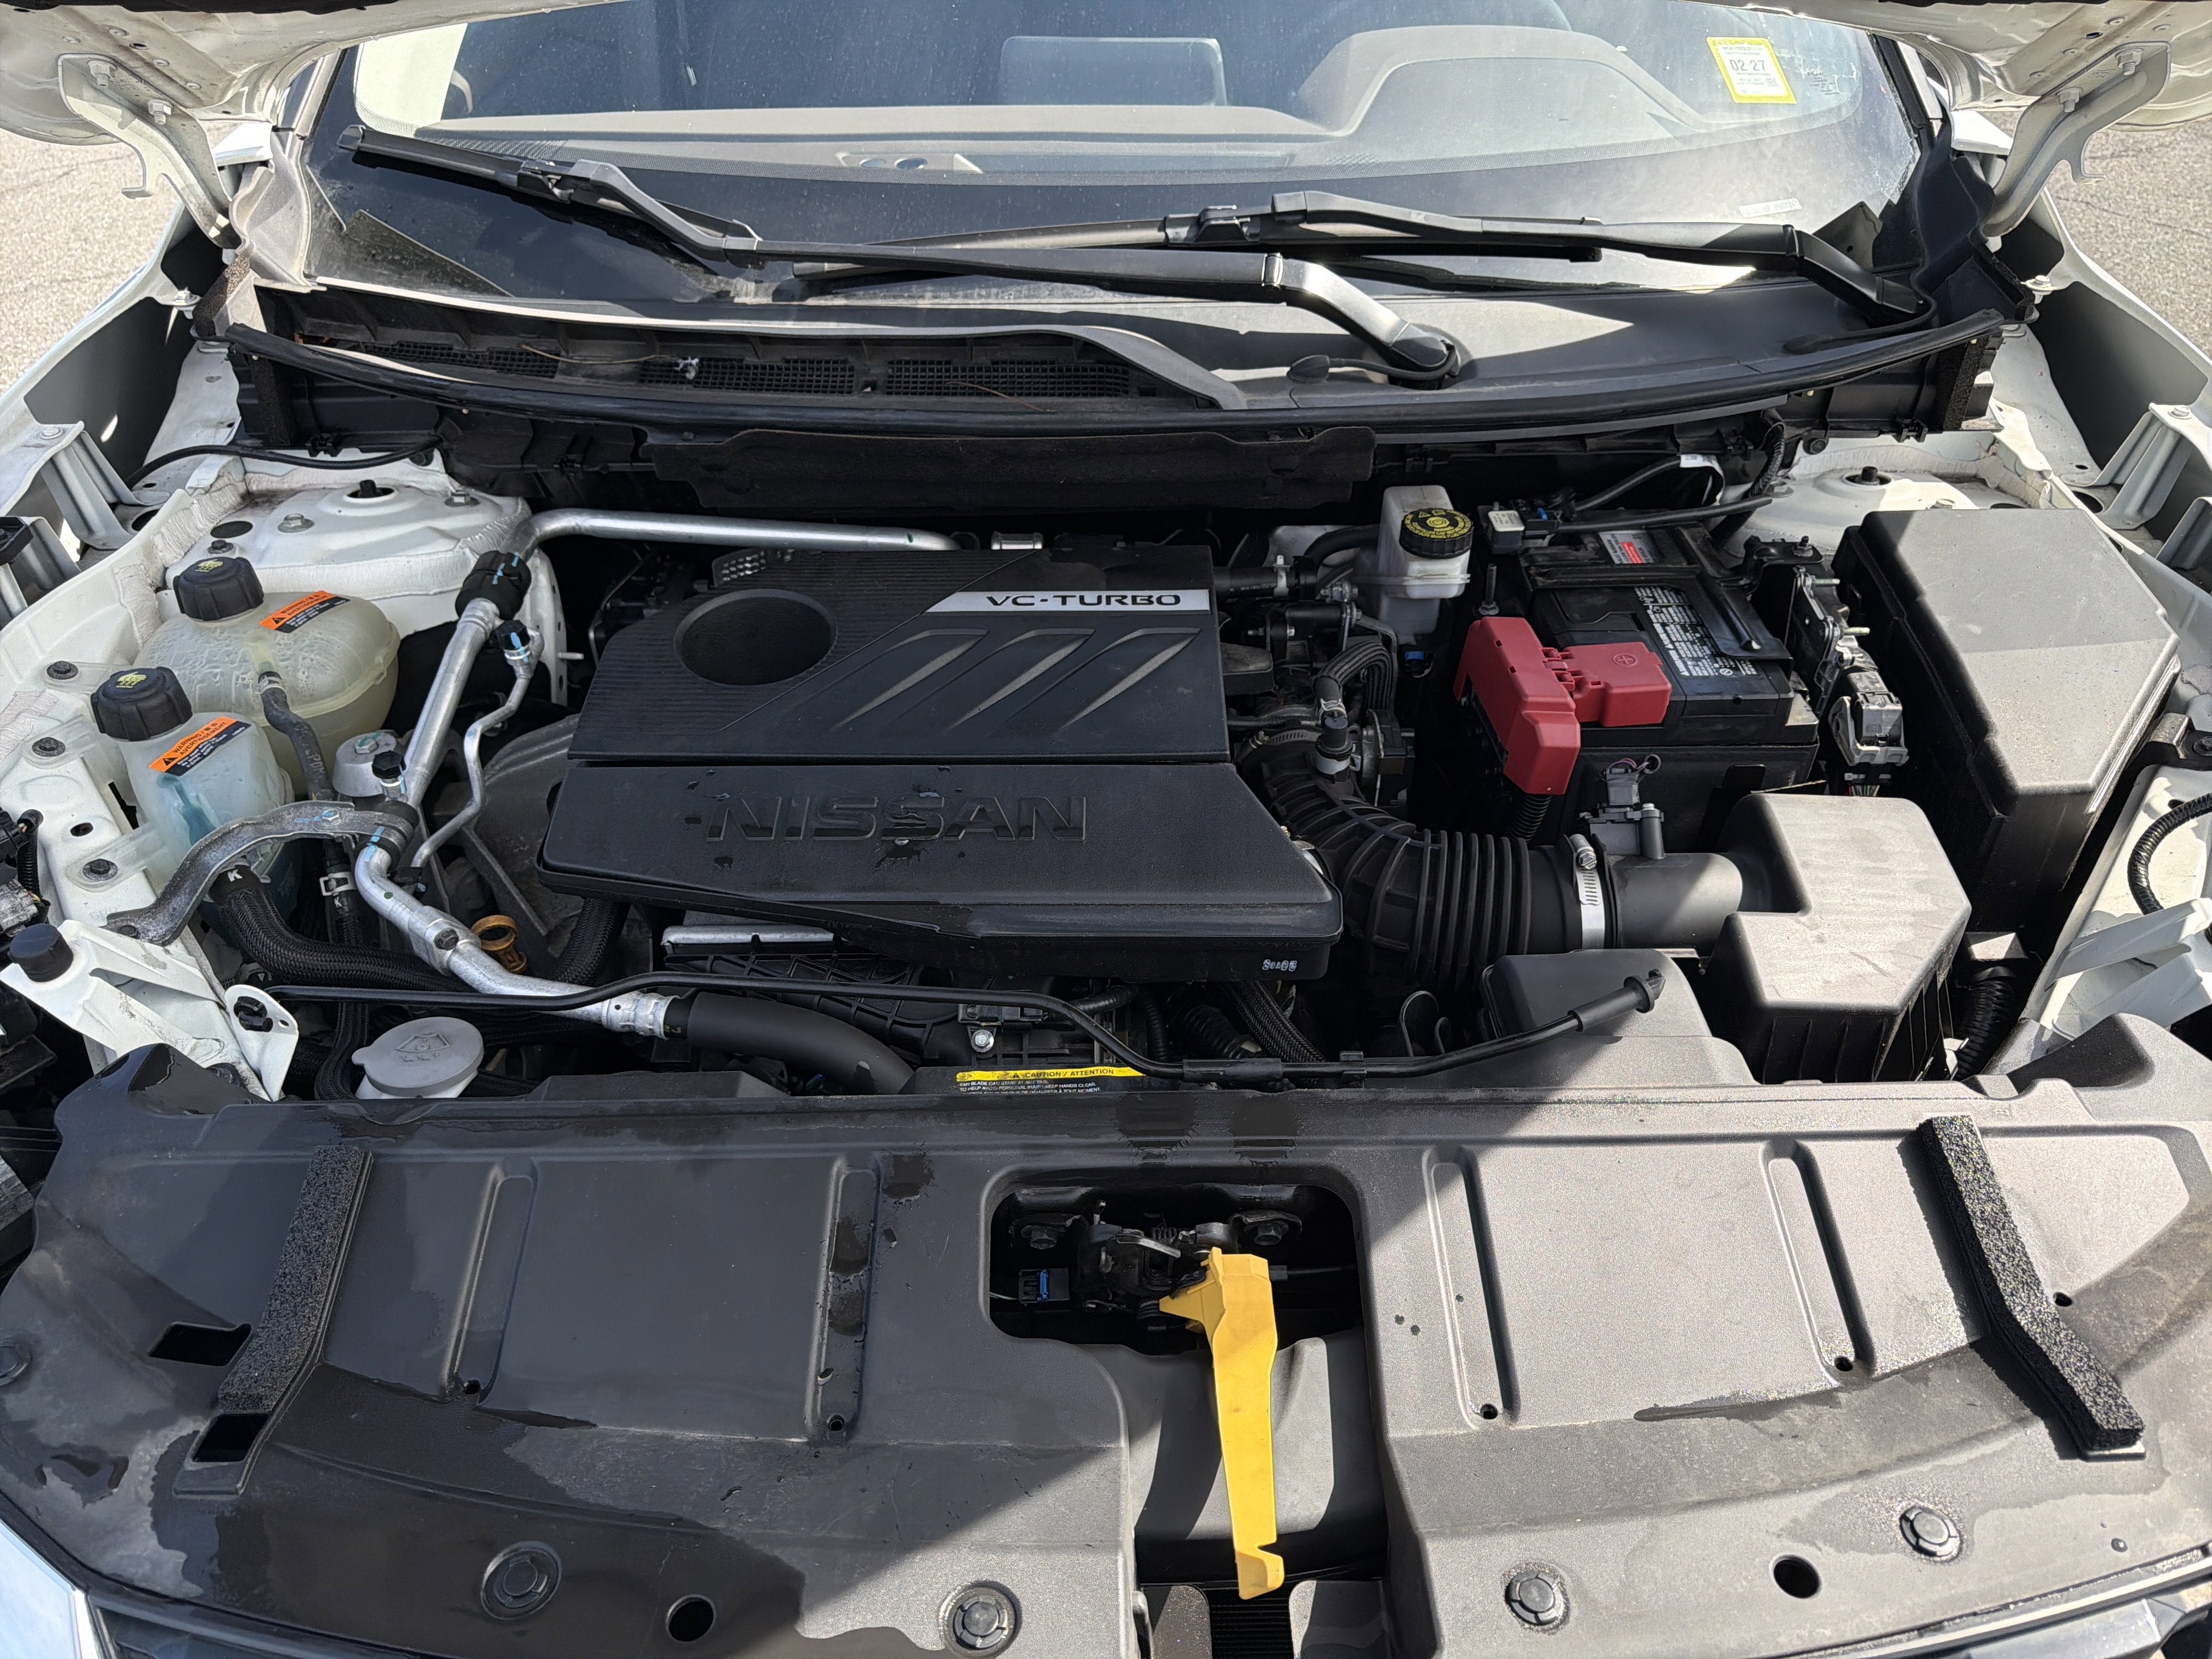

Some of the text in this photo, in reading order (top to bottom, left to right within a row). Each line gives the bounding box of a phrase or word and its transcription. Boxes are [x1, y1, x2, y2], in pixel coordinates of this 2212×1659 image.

[1730, 59, 1765, 71] 02 27
[986, 594, 1181, 607] VC-TURBO
[172, 733, 202, 753] WARNING
[706, 795, 1087, 842] NISSAN
[227, 869, 243, 882] K
